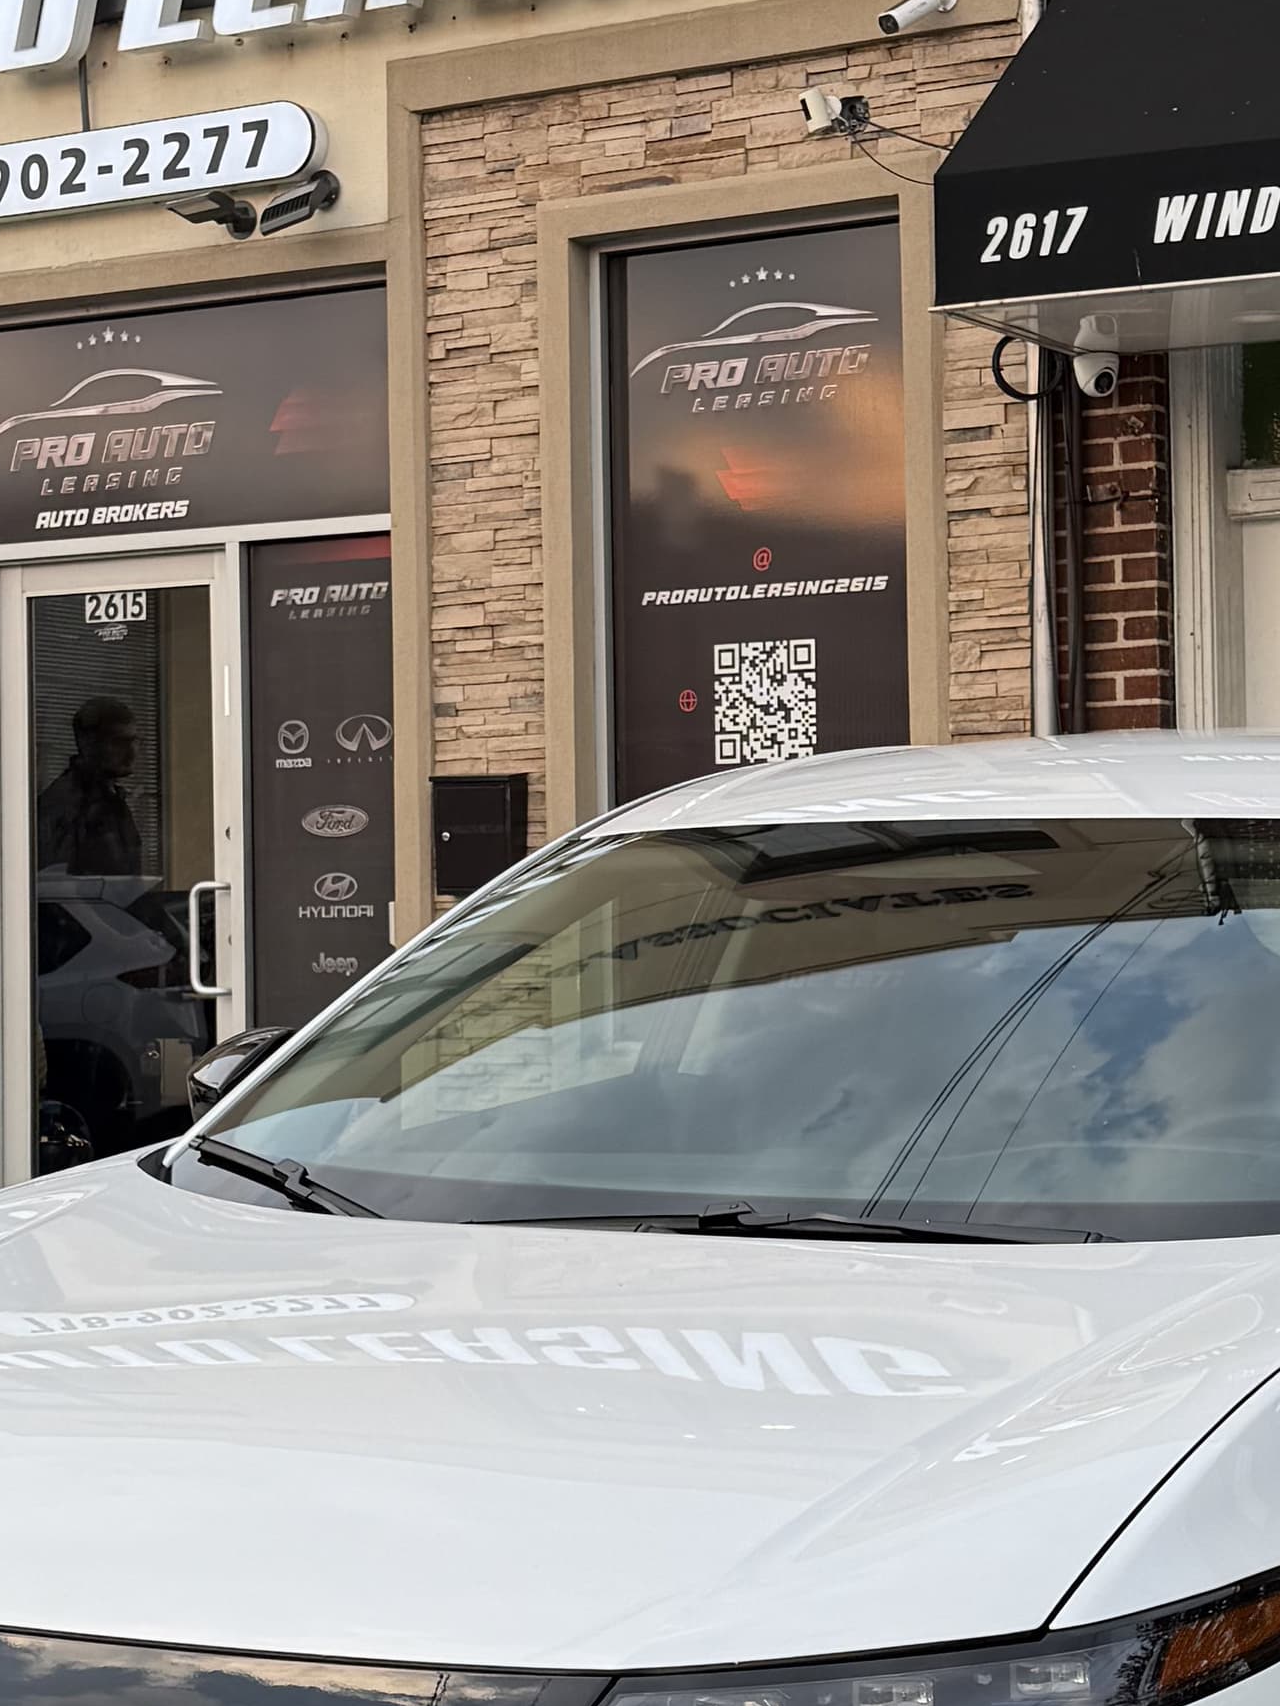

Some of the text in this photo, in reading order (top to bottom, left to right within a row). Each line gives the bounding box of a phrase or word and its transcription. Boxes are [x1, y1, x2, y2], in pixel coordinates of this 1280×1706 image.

[980, 206, 1088, 264] 2617
[661, 344, 871, 394] PRO AUTO
[691, 384, 838, 414] LEASING
[10, 421, 216, 472] PRO AUTO
[41, 467, 183, 496] LEASING
[35, 500, 190, 530] AUTO BROKERS
[270, 582, 389, 608] PRO AUTO
[641, 575, 889, 606] PROAUTOLEASING2615
[88, 593, 143, 621] 2615
[276, 758, 313, 769] mazda
[315, 810, 355, 832] Ford
[298, 905, 374, 919] HYUNDAI
[312, 952, 358, 976] Jeep
